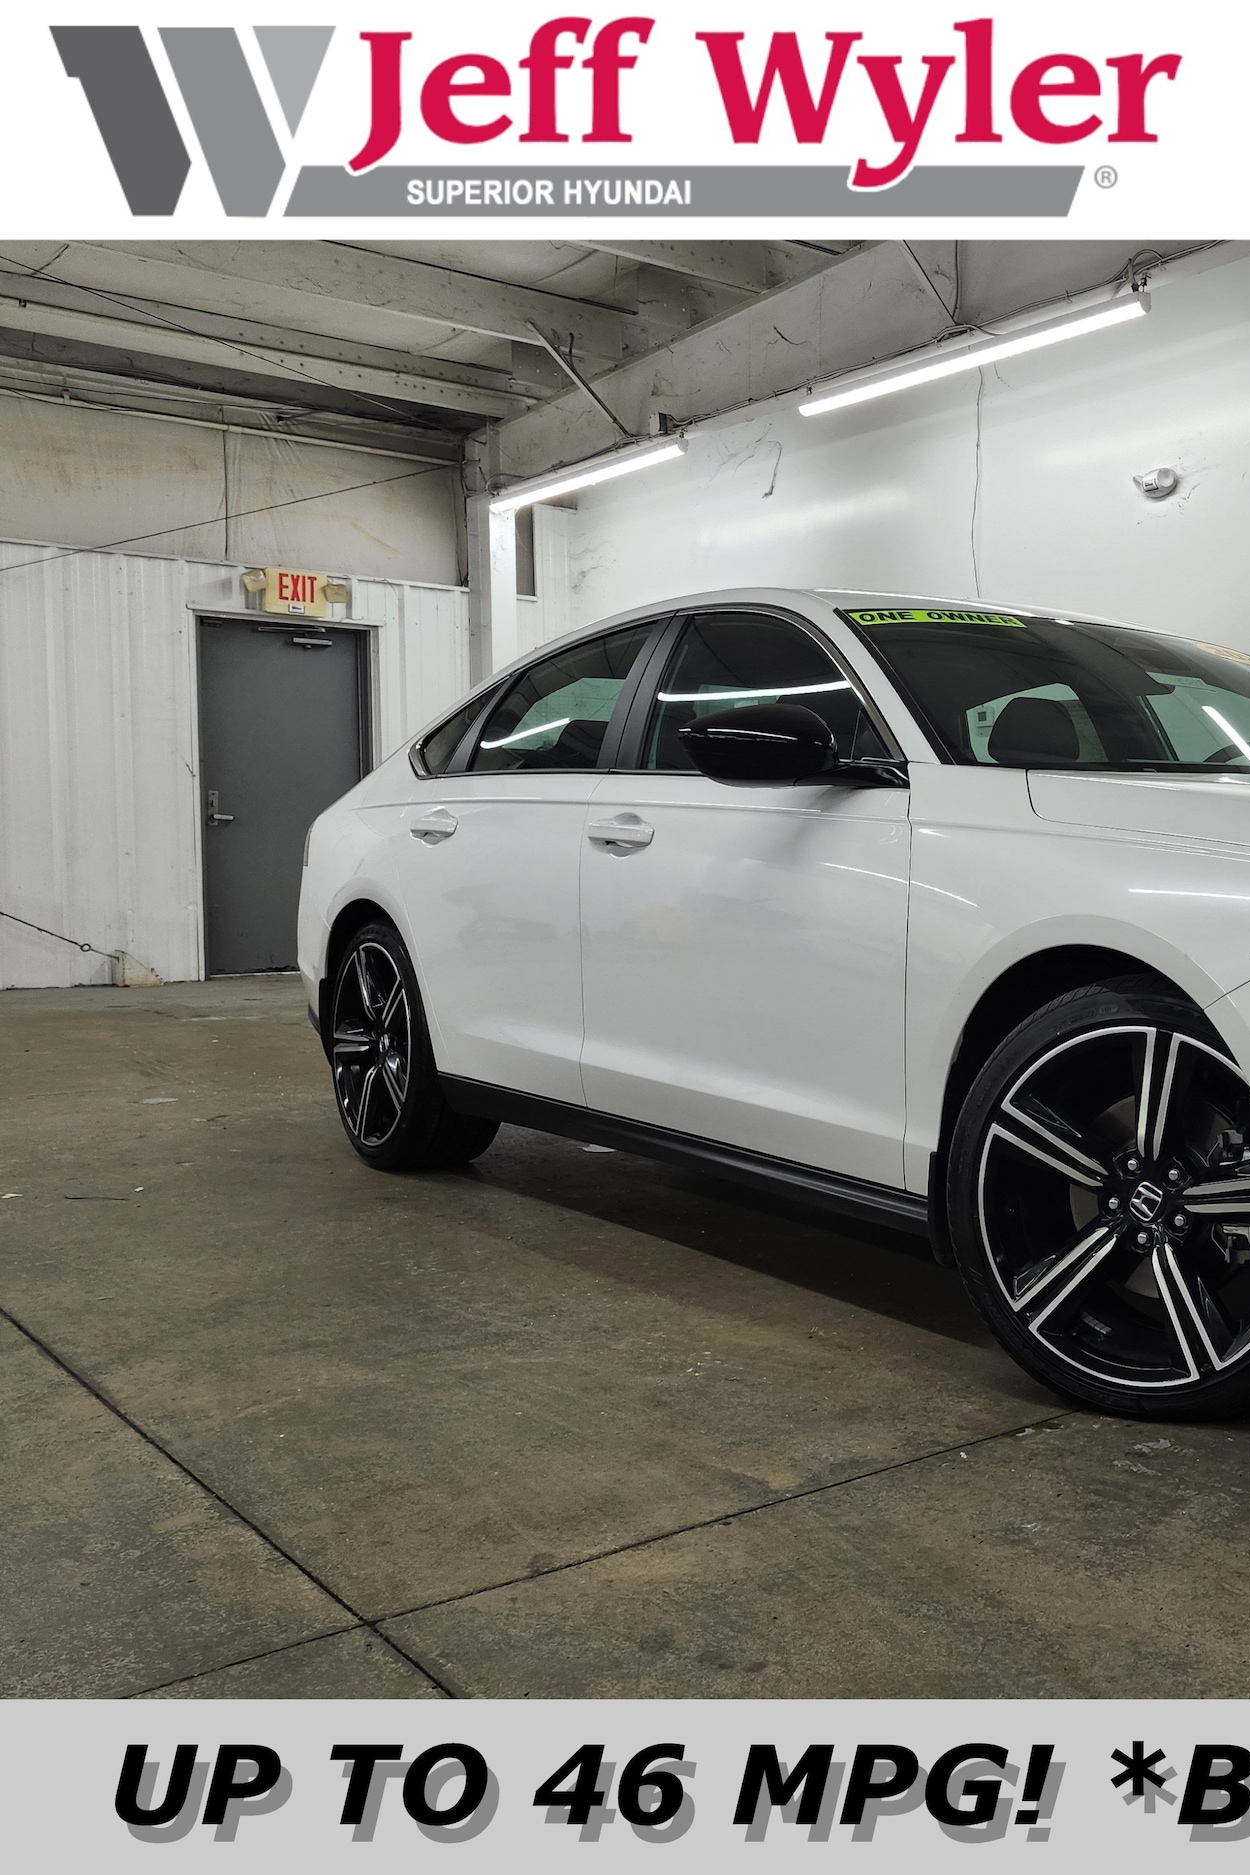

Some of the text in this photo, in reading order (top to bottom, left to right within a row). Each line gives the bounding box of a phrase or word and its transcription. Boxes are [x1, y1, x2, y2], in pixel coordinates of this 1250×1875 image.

[278, 573, 317, 603] EXIT
[859, 611, 1019, 625] ONE OWNER
